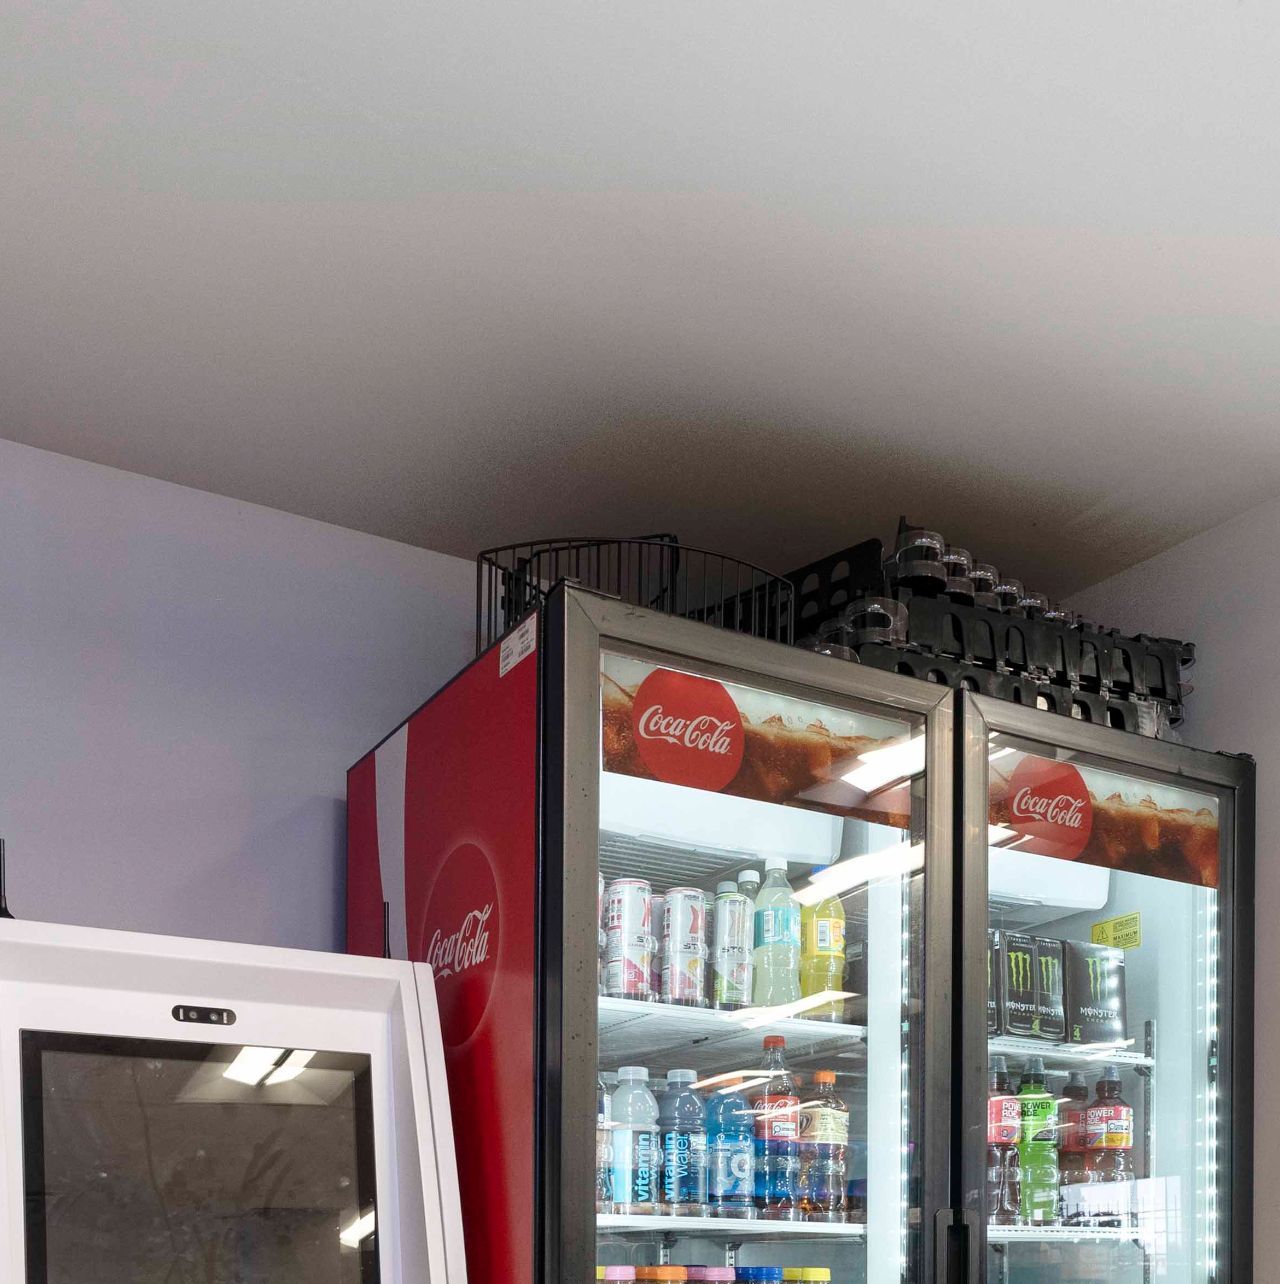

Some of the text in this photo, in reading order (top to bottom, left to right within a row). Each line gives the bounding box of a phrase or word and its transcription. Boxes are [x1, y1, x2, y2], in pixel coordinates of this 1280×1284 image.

[639, 704, 733, 756] Coca-Cola
[1011, 786, 1083, 830] Coca-Cola
[426, 902, 494, 979] Coca-Cola
[1038, 1005, 1063, 1016] MONSTE
[1079, 1006, 1118, 1019] MONSTER
[1002, 1102, 1021, 1112] POW
[635, 1133, 650, 1202] vitamin
[664, 1133, 675, 1201] vitamin
